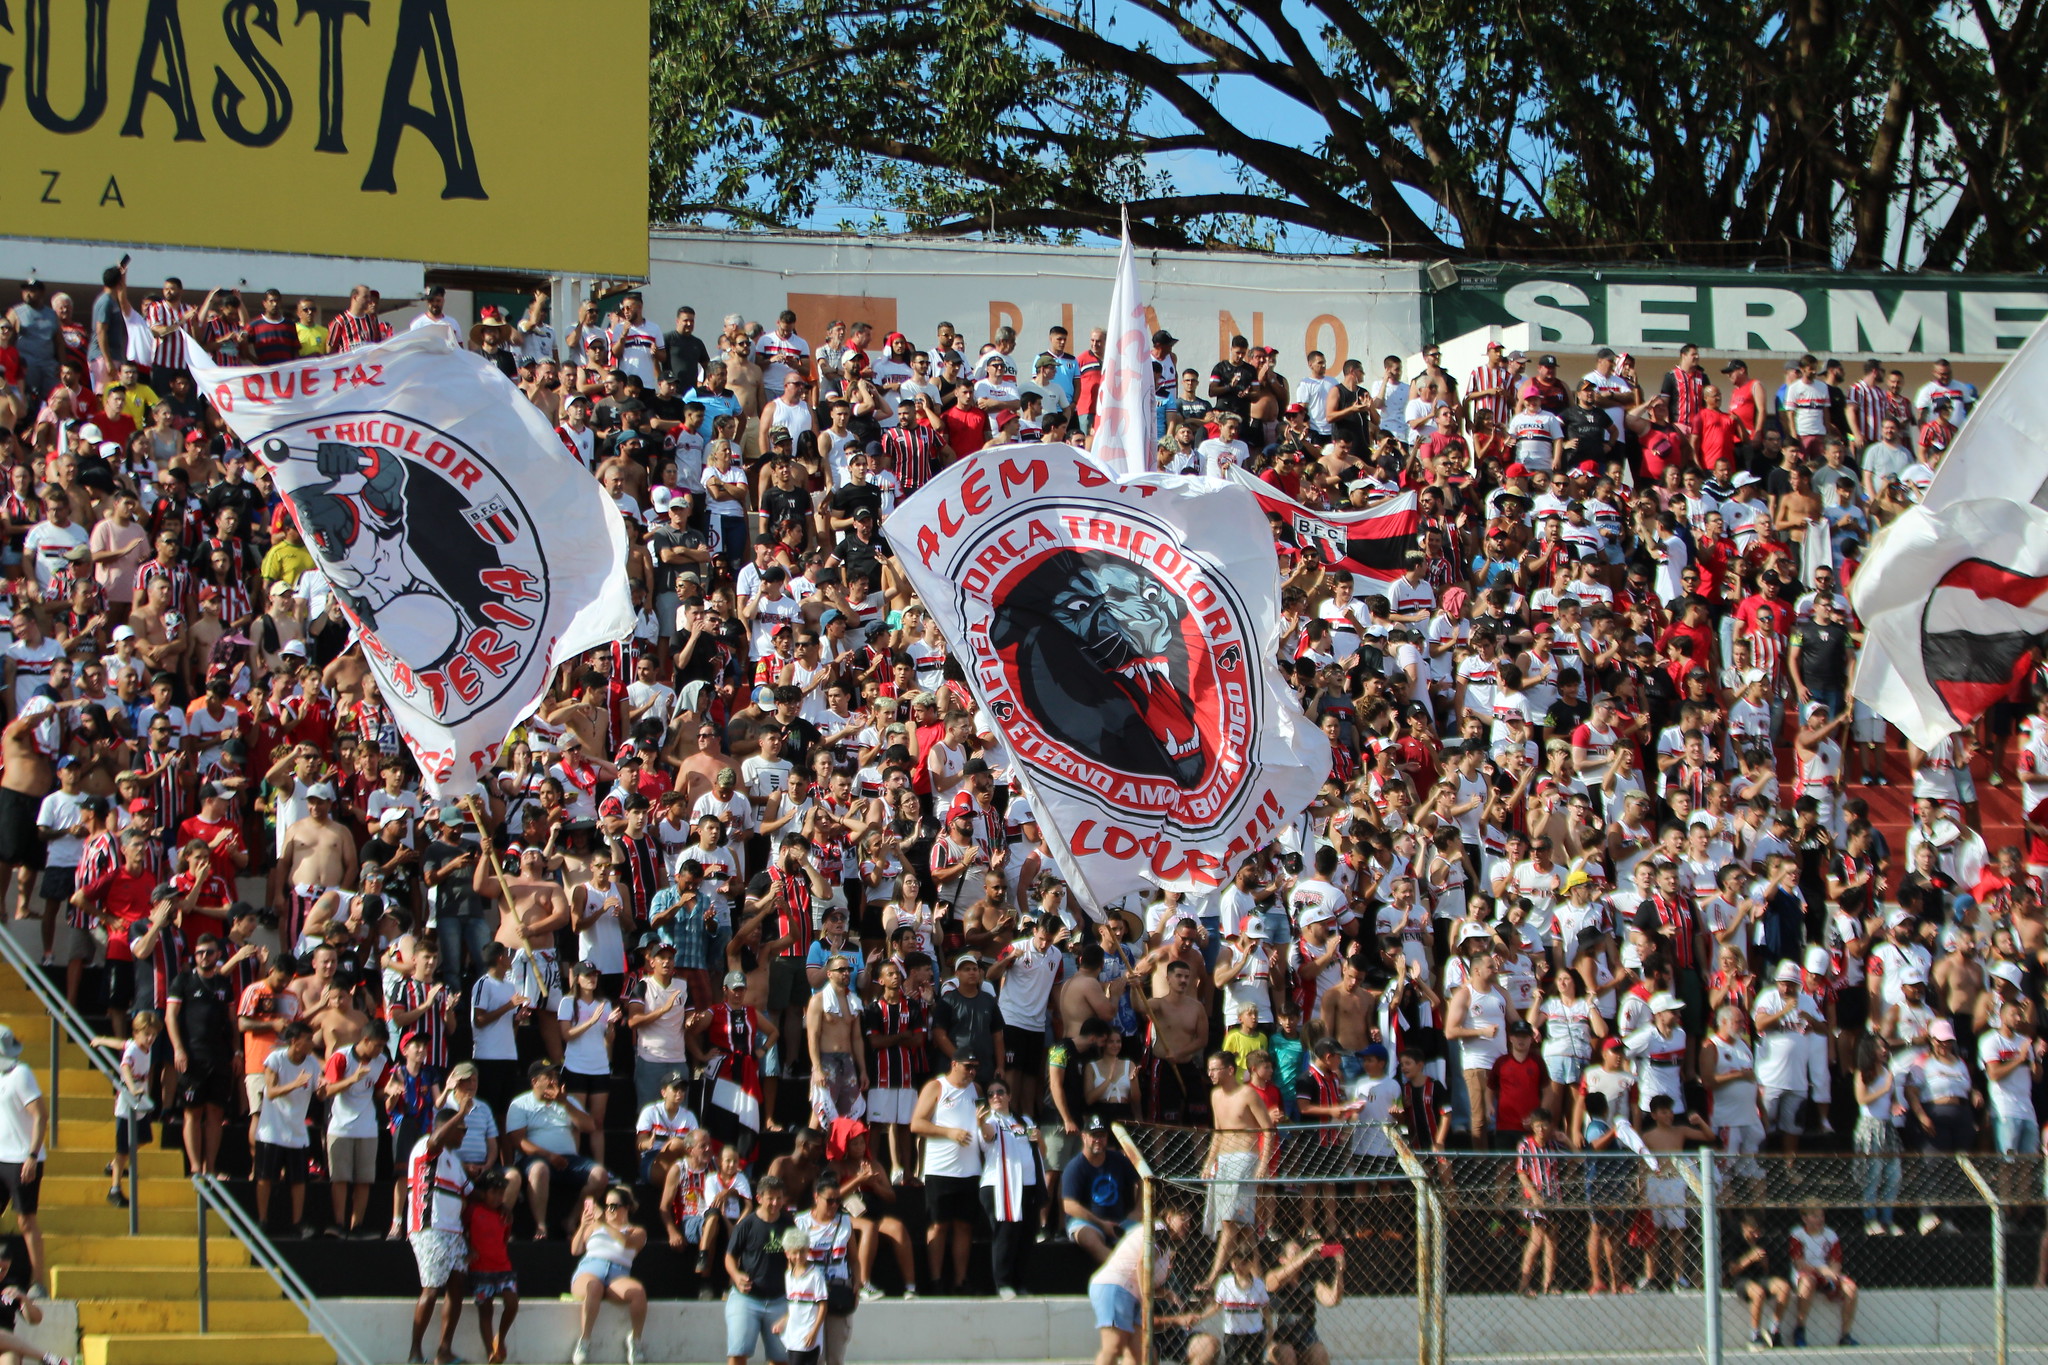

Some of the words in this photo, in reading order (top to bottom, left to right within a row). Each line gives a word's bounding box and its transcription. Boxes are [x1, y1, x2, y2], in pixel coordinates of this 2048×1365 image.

[243, 367, 320, 405] QUE
[332, 363, 386, 393] FAZ
[306, 419, 484, 491] TRICOLOR
[916, 457, 1050, 572] ALÉM
[970, 614, 1006, 694] FIEL
[1061, 515, 1234, 642] TRICOLOR
[1008, 720, 1115, 794] ETERNO
[1188, 681, 1247, 819] BOTAFOGO
